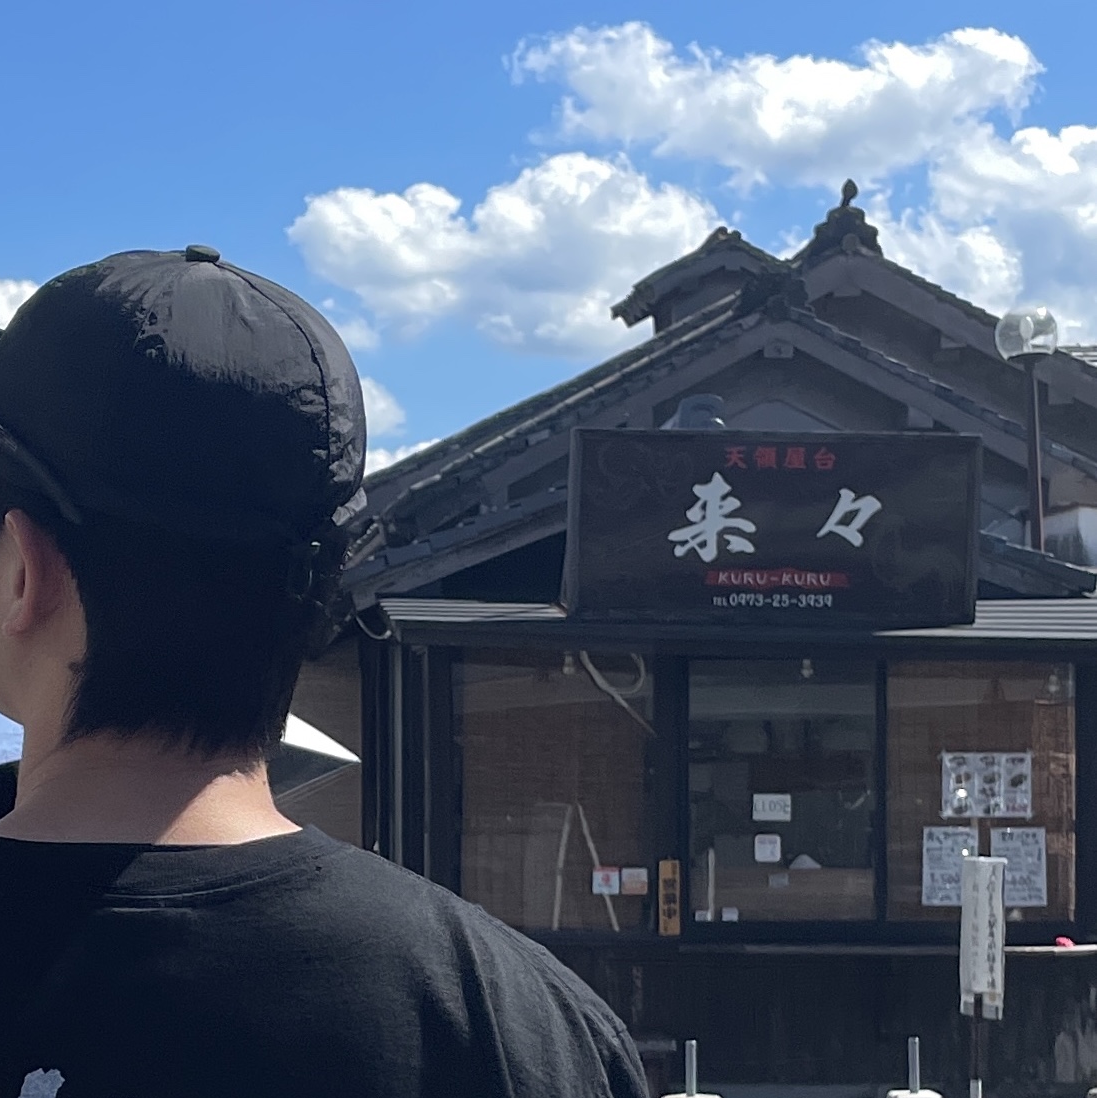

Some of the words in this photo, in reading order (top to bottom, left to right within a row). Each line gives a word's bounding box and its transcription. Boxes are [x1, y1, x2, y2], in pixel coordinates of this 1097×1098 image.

[724, 446, 836, 470] 天領屋台
[717, 571, 831, 586] KURU-KURU
[729, 594, 833, 608] 0973-25-3939
